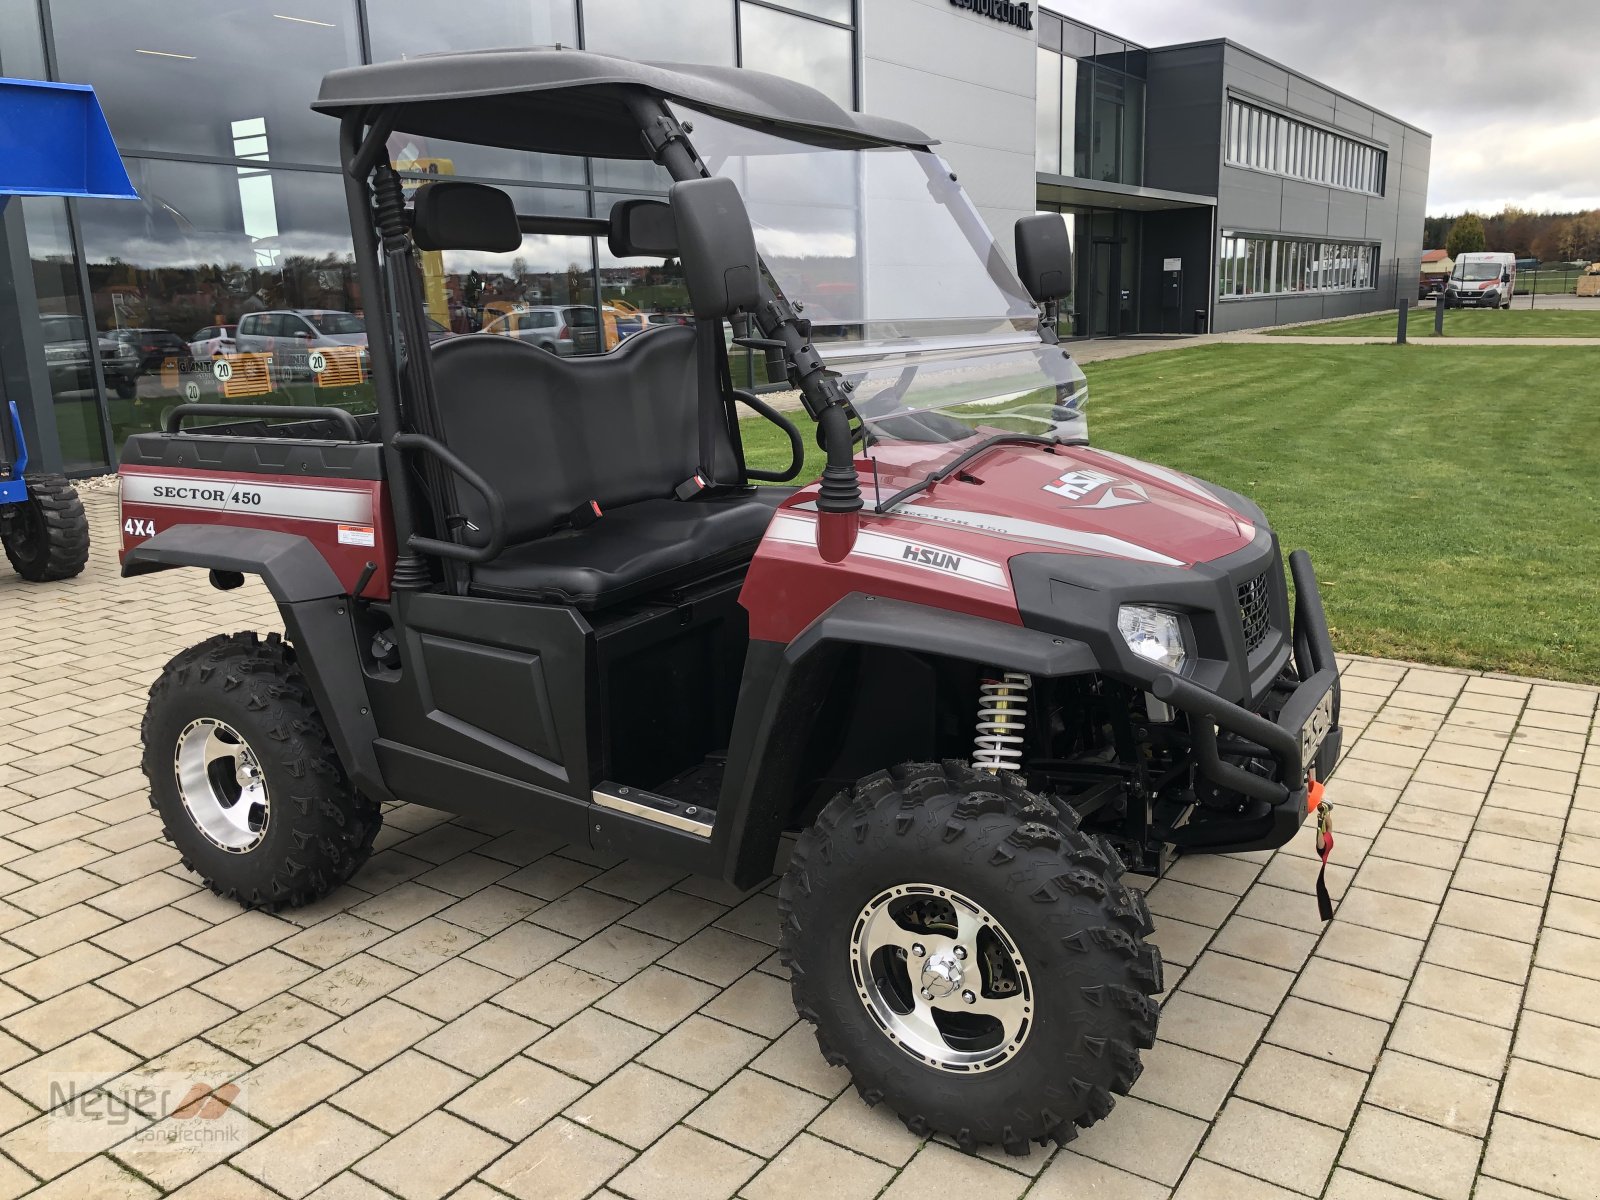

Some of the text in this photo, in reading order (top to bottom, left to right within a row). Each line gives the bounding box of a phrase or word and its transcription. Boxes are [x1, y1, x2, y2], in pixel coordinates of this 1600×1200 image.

[312, 356, 323, 369] 20
[217, 363, 229, 378] 20
[188, 385, 198, 399] 20
[152, 484, 262, 506] SECTOR 450
[124, 518, 156, 538] 4X4
